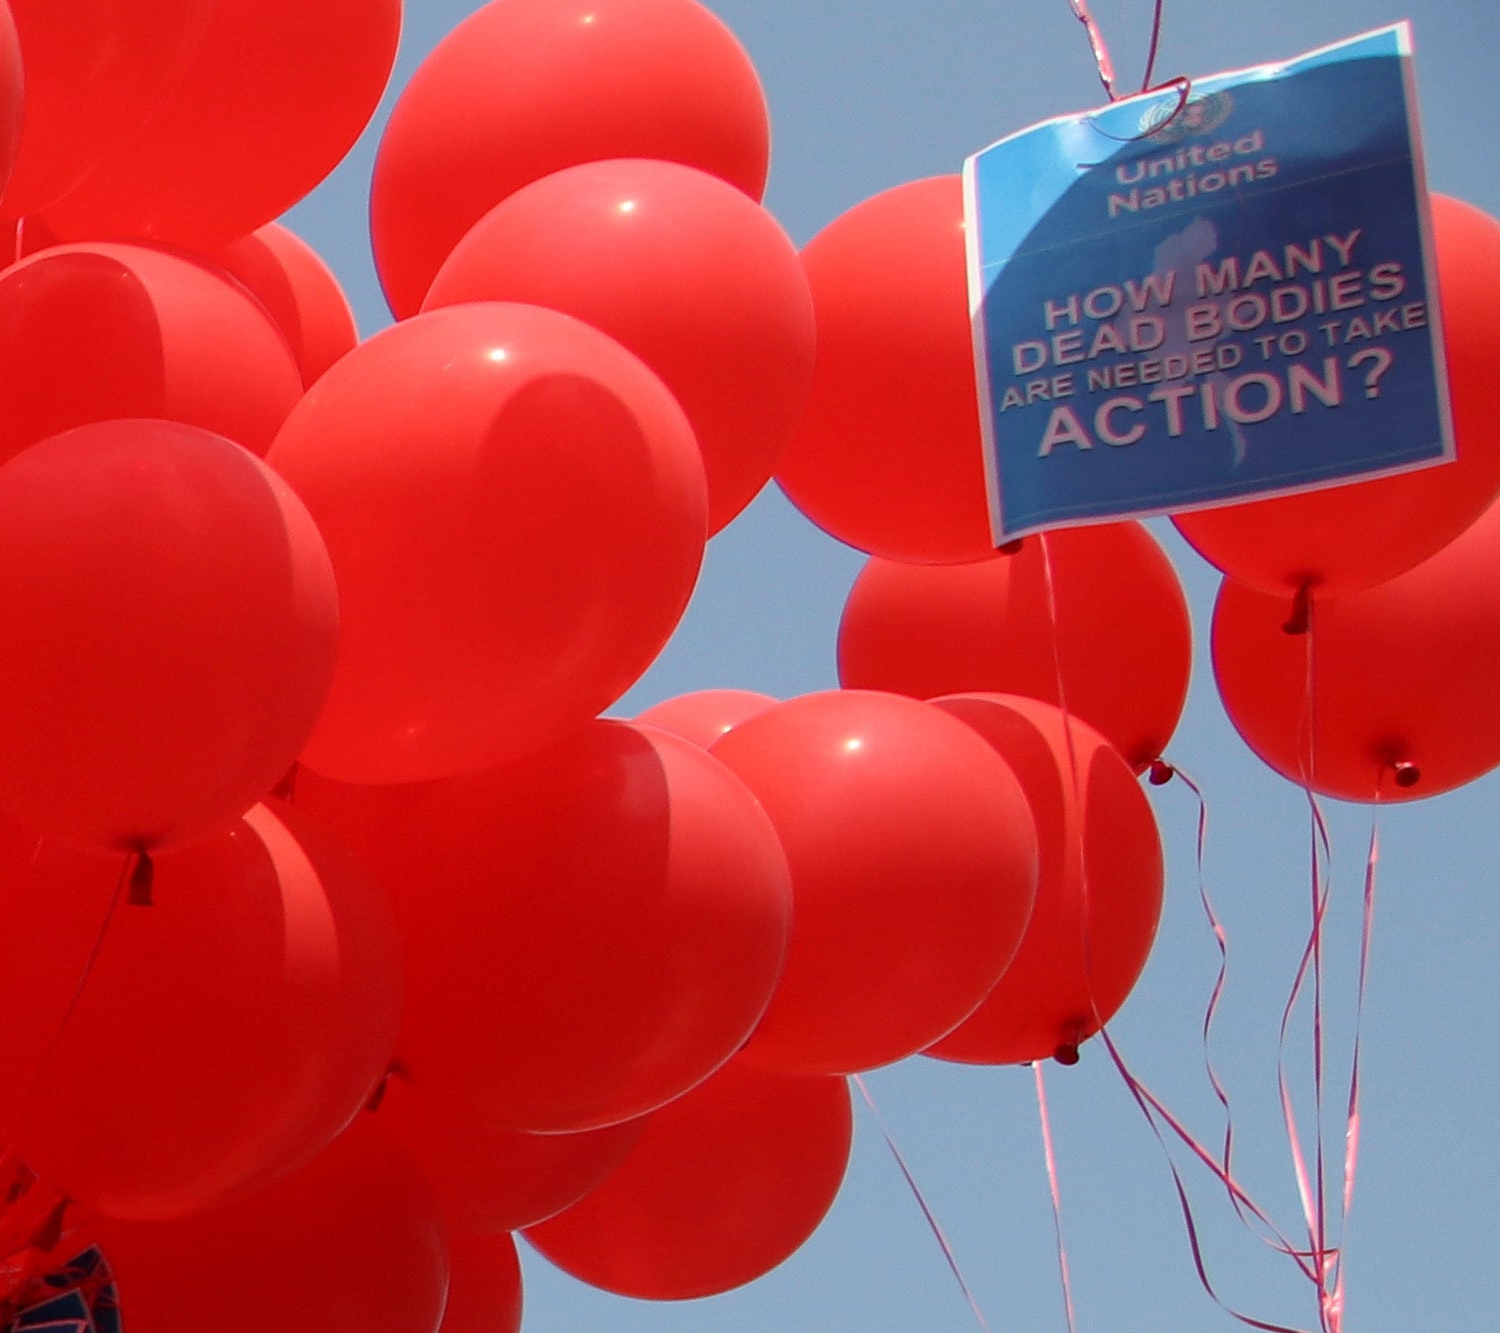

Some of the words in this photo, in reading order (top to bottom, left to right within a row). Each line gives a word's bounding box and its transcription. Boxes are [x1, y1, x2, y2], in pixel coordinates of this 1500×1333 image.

[1108, 158, 1277, 218] Nations
[1116, 130, 1265, 185] United
[1013, 315, 1165, 376] DEAD
[1187, 263, 1405, 343] BODIES
[1044, 269, 1177, 332] HOW
[1199, 230, 1362, 299] MANY
[1000, 373, 1074, 413] ARE
[1088, 344, 1240, 393] NEEDED
[1255, 330, 1306, 360] TO
[1320, 304, 1427, 348] TAKE
[1038, 348, 1395, 457] ACTION?
